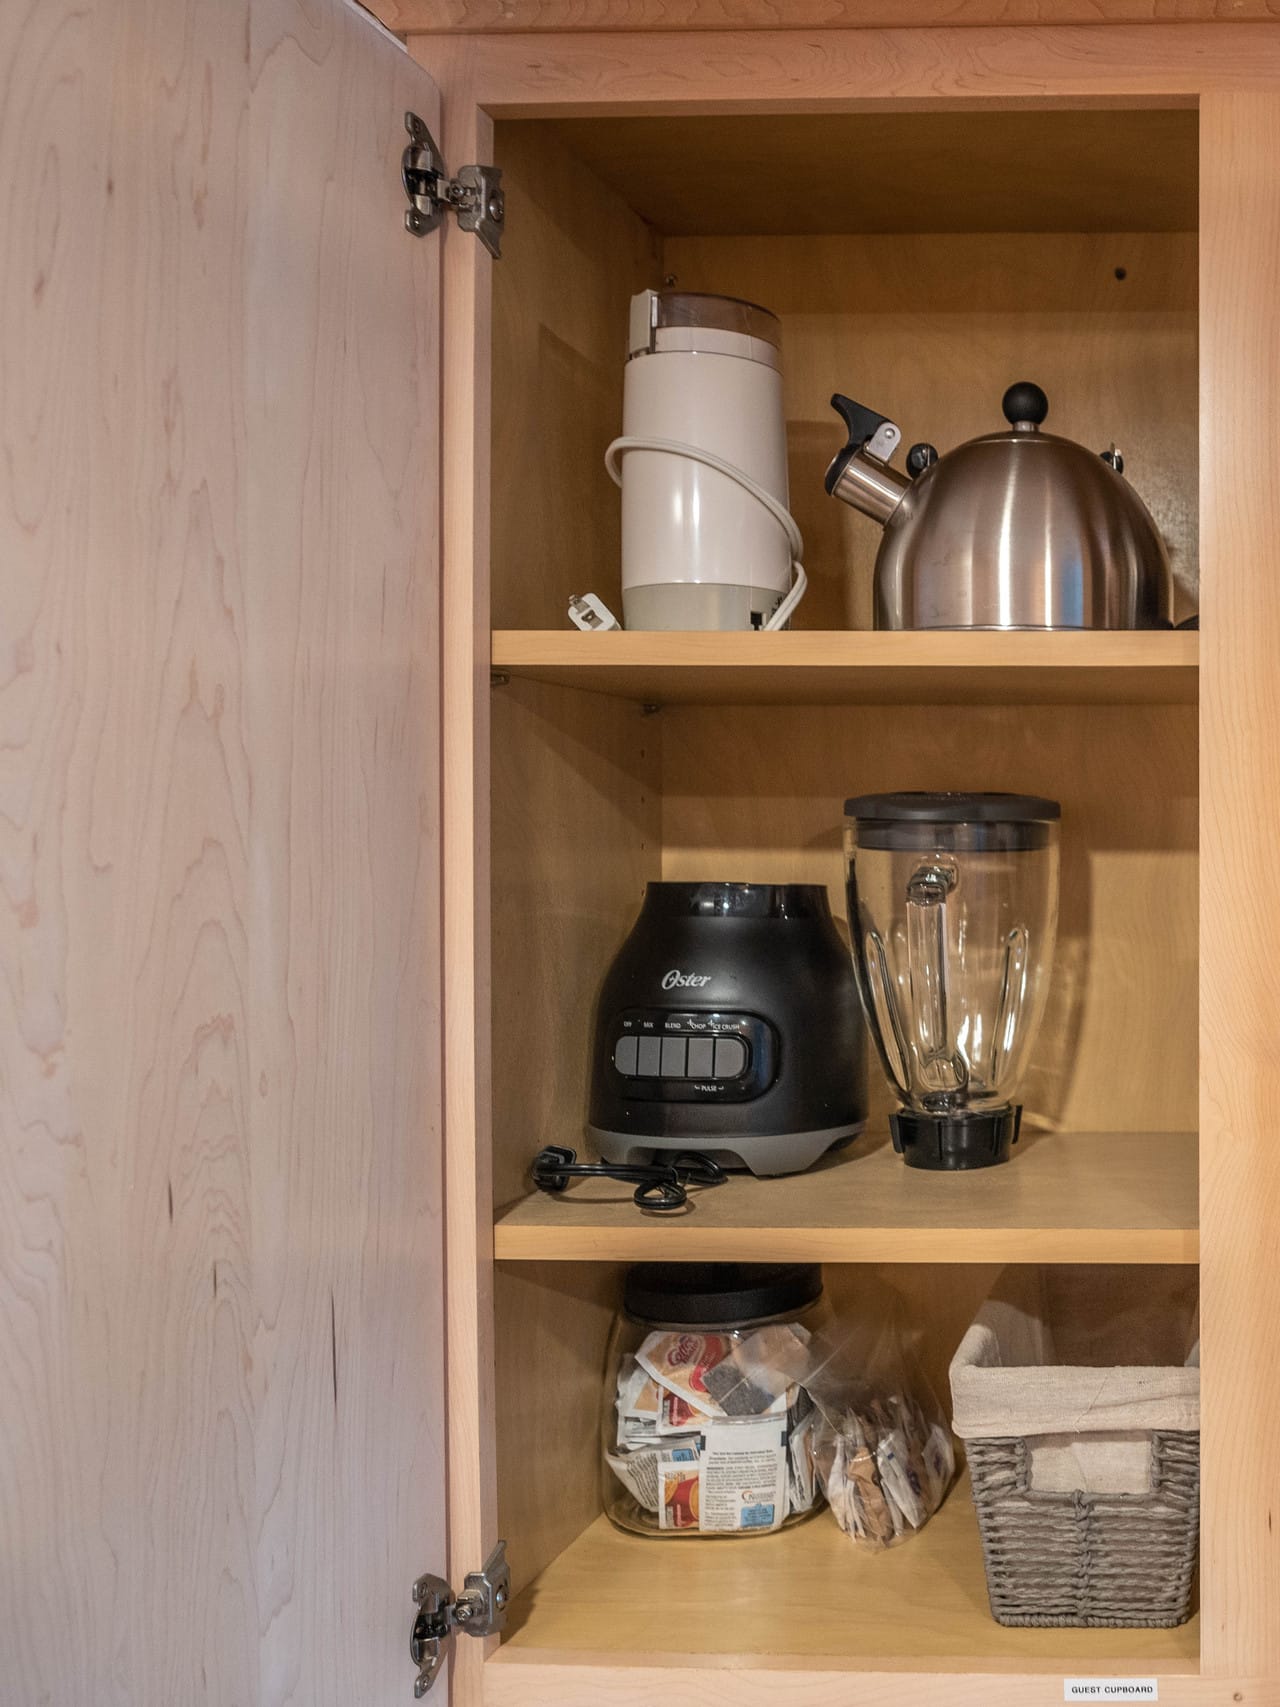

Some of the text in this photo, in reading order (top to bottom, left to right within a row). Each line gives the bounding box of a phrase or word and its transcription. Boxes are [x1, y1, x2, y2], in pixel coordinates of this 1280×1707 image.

[661, 969, 712, 990] Oster
[1071, 1685, 1153, 1694] GUEST CUPBOARD
